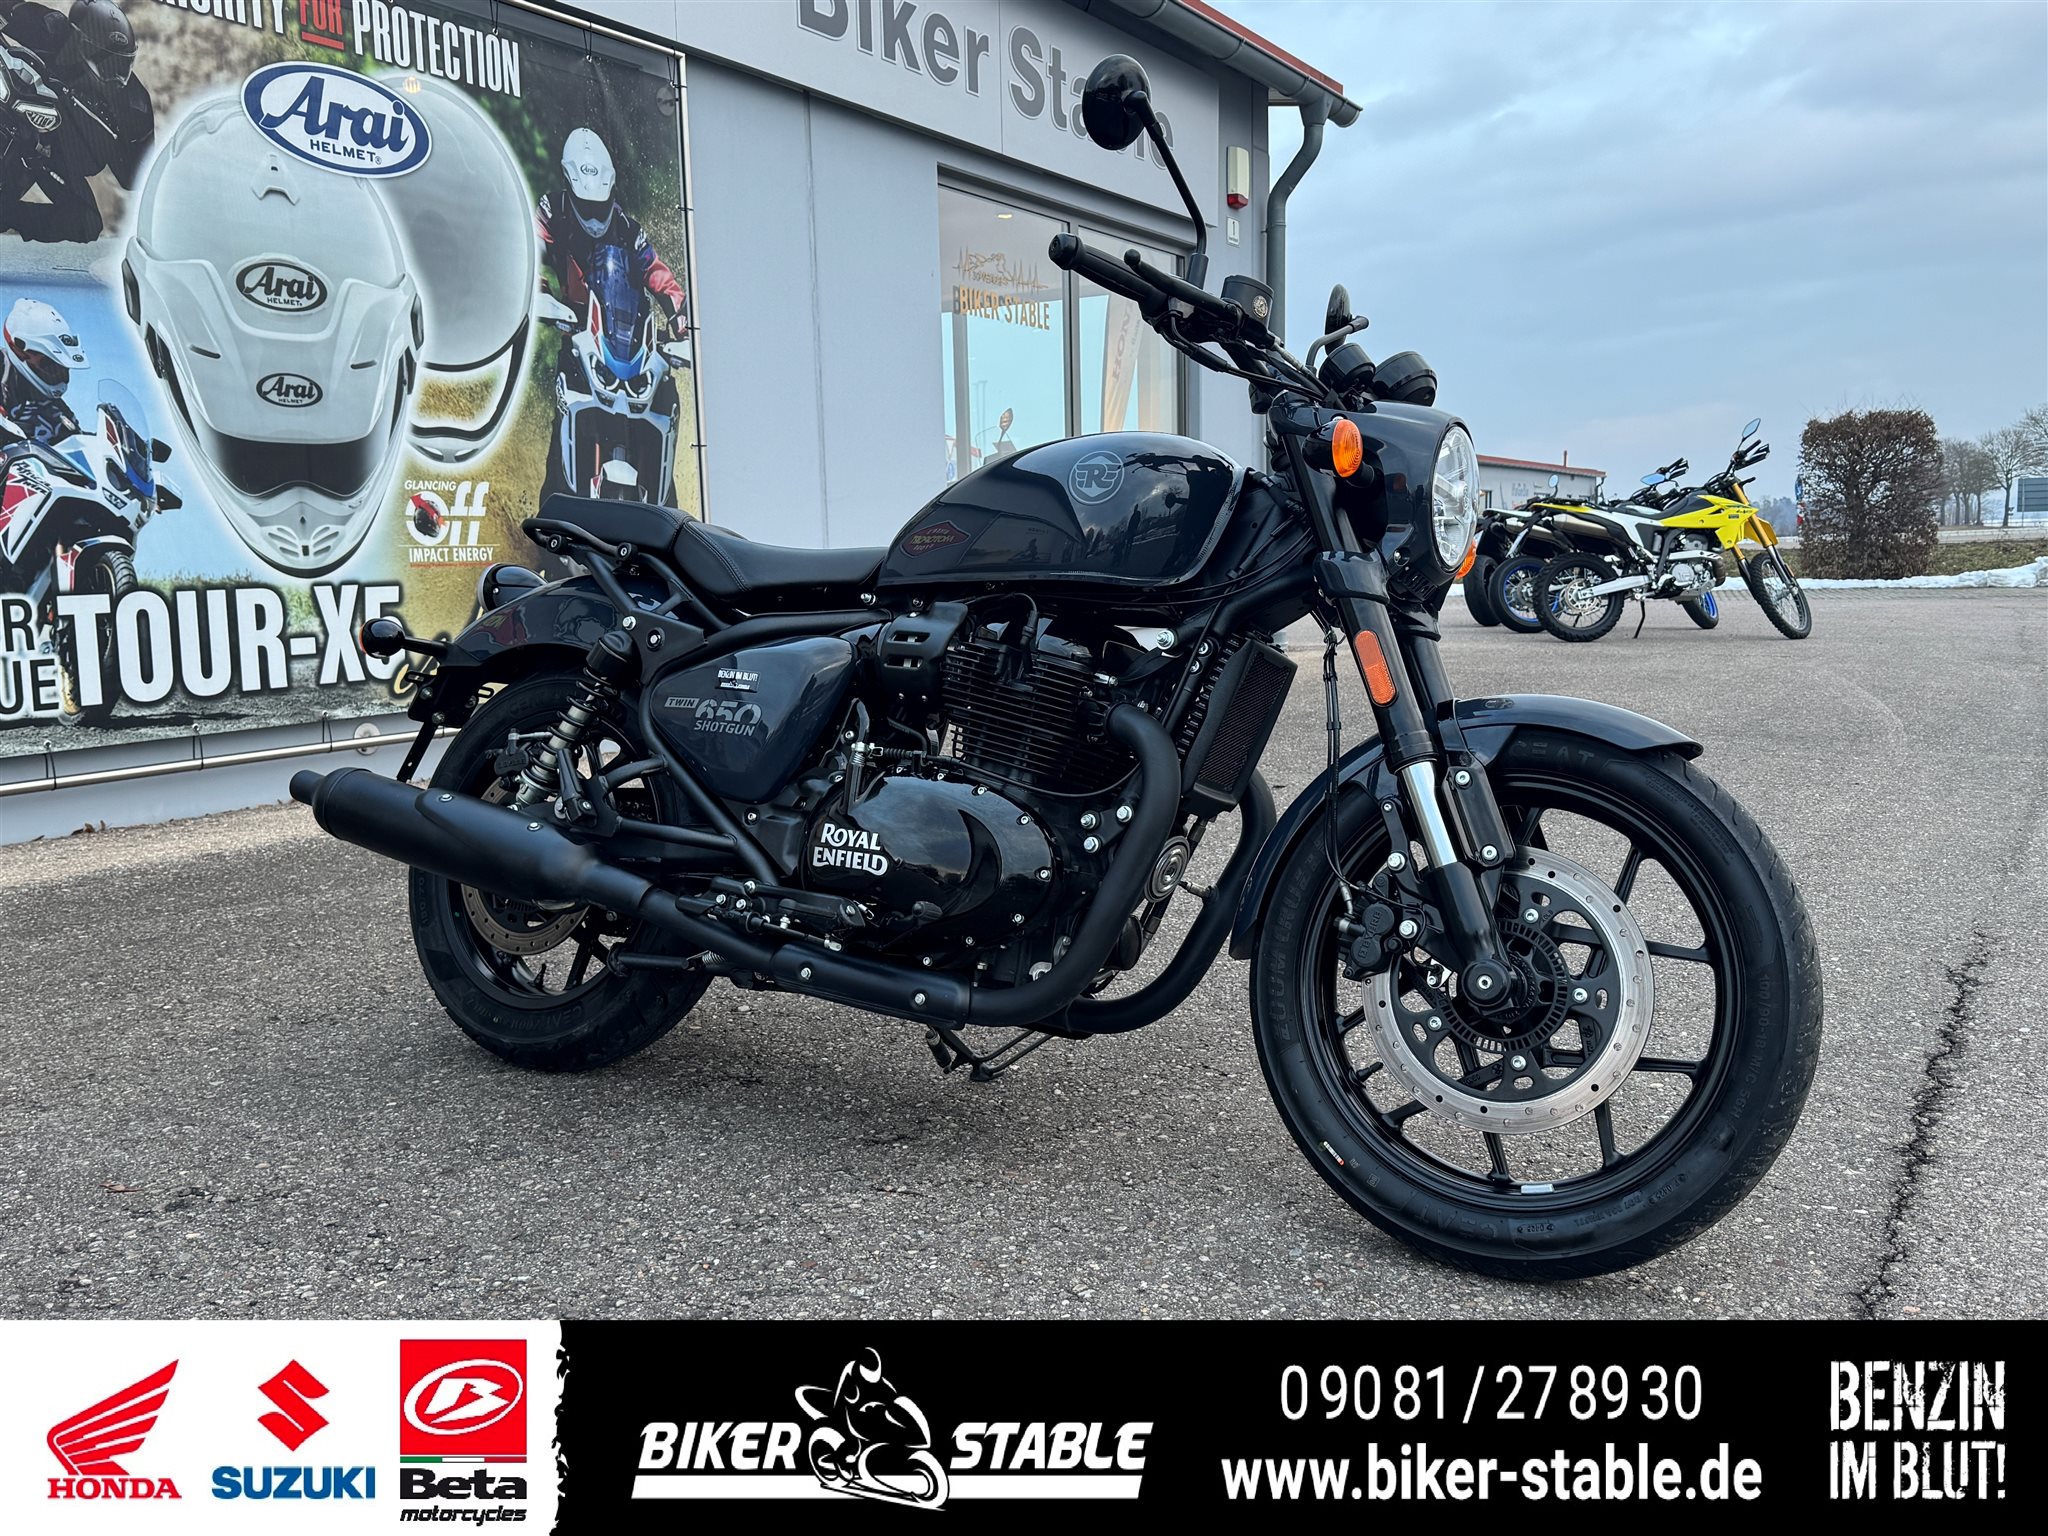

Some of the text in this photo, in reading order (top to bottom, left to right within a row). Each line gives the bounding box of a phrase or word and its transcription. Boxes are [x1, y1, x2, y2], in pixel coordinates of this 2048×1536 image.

[352, 0, 521, 98] PROTECTION
[258, 76, 410, 152] Arai
[243, 266, 318, 300] Arai
[1004, 294, 1050, 331] STABLE
[262, 376, 316, 399] Arai
[404, 480, 457, 491] GLANCING
[405, 481, 490, 546] Off
[409, 546, 494, 562] IMPACT ENERGY
[57, 584, 405, 707] TOUR-X5
[668, 698, 695, 707] TWIN
[695, 699, 762, 724] 650
[694, 720, 755, 736] SHOTGUN
[821, 823, 881, 851] ROYAL
[812, 846, 888, 876] ENFIELD
